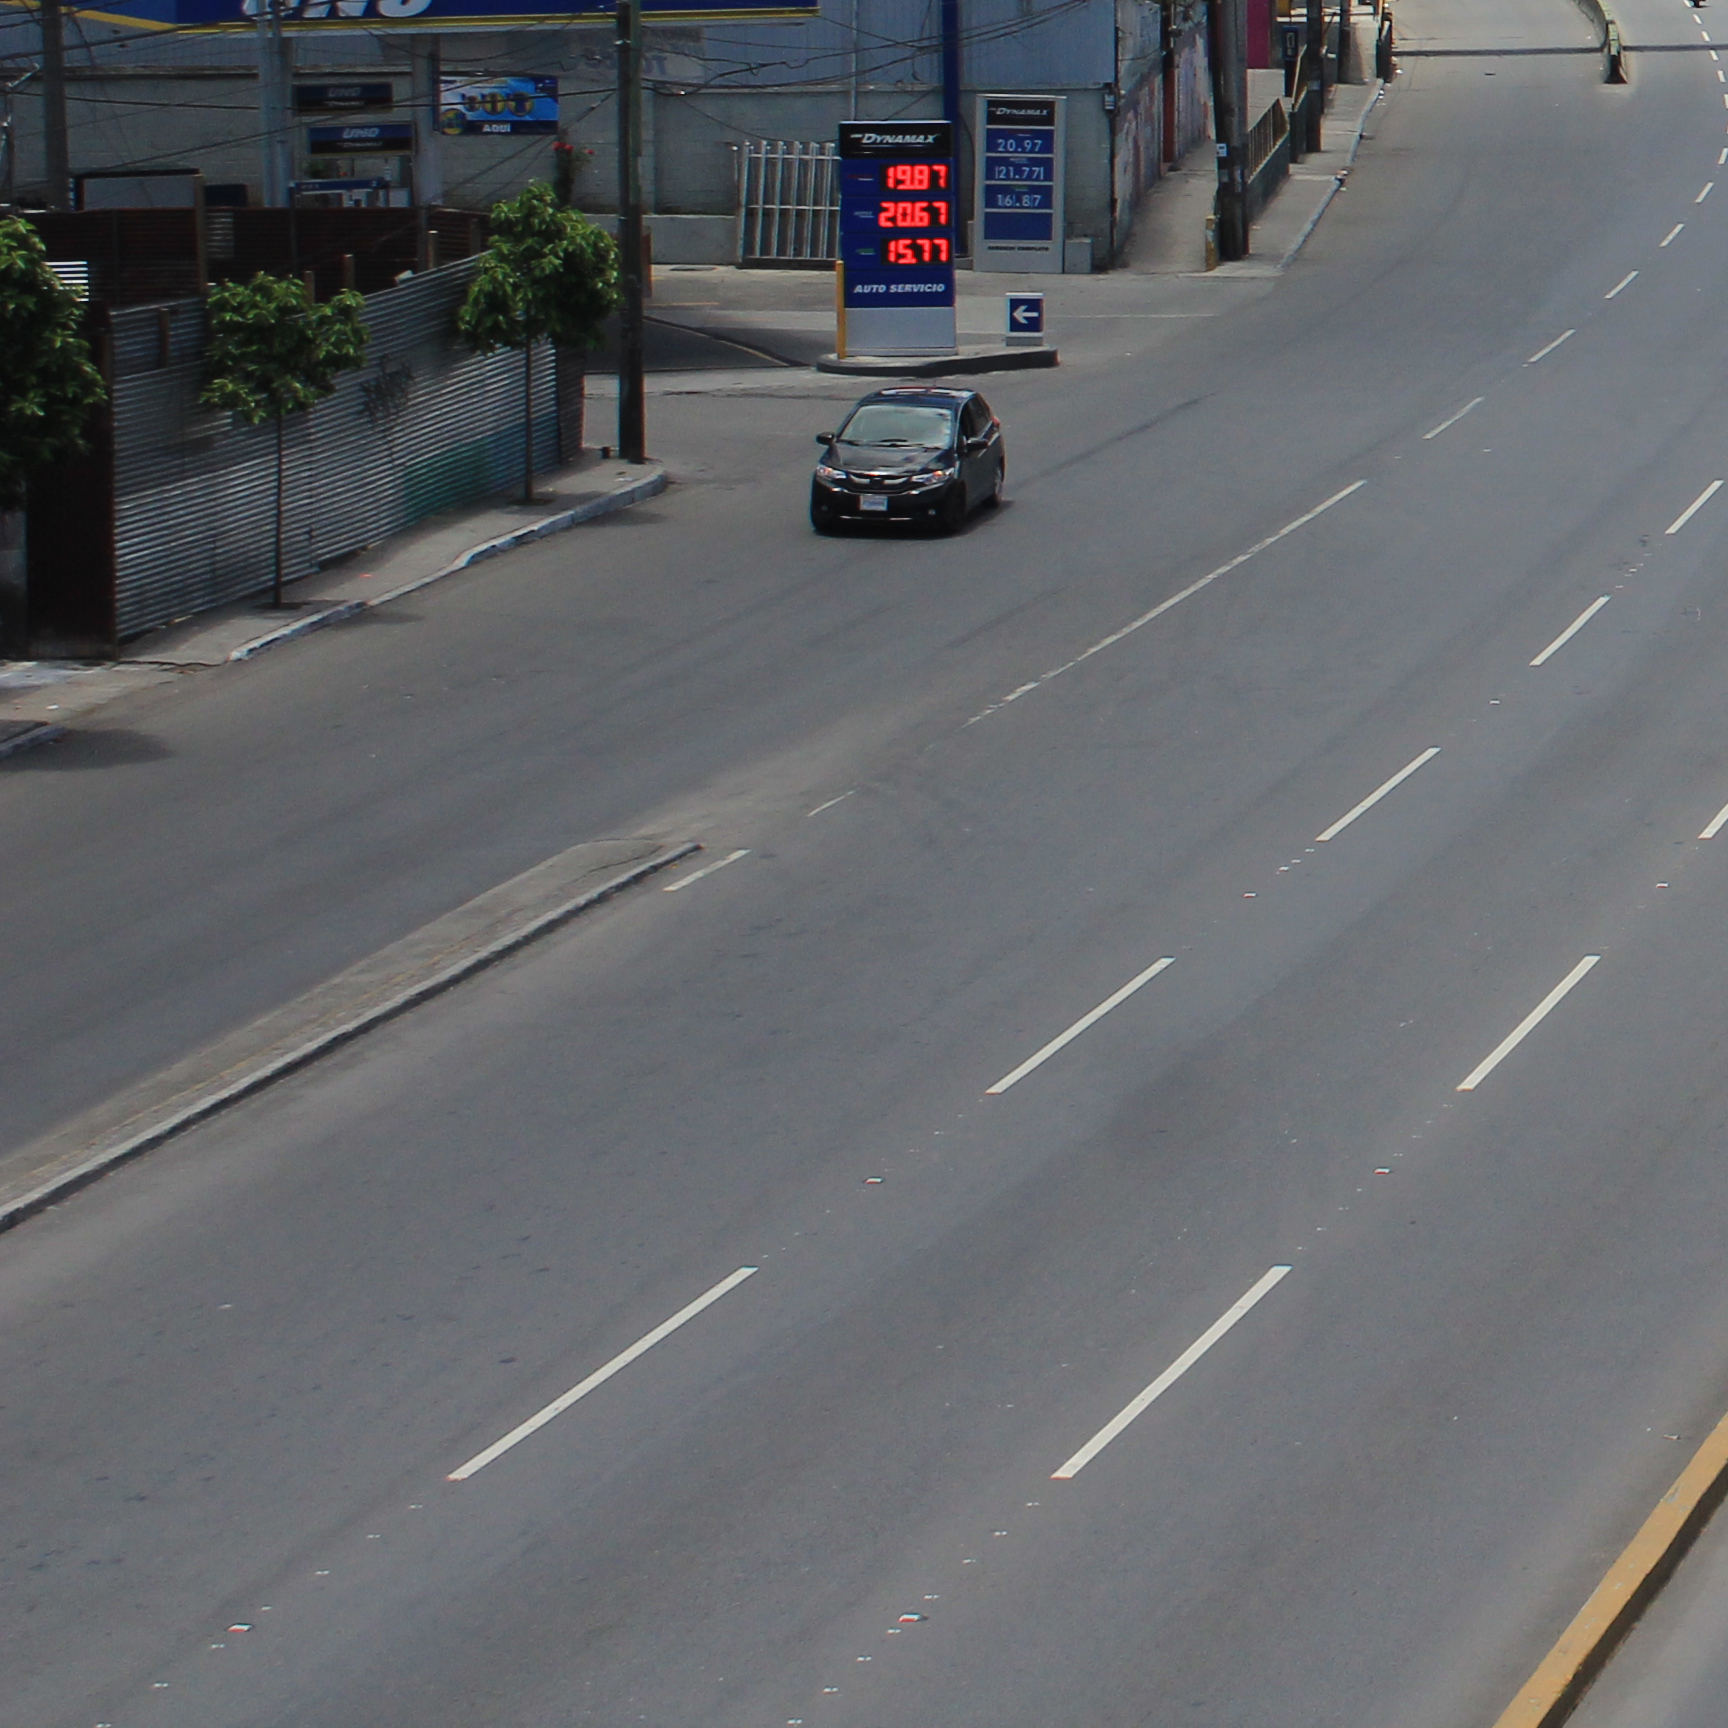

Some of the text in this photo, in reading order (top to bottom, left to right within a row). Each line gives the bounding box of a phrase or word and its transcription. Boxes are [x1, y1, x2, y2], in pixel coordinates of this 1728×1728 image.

[996, 107, 1050, 116] DYNAMAX
[861, 133, 937, 144] DYNAMAX
[996, 139, 1043, 152] 20.97
[998, 167, 1042, 180] 21.77
[996, 195, 1042, 207] 16.87
[853, 284, 946, 294] AUTO SERVICIO
